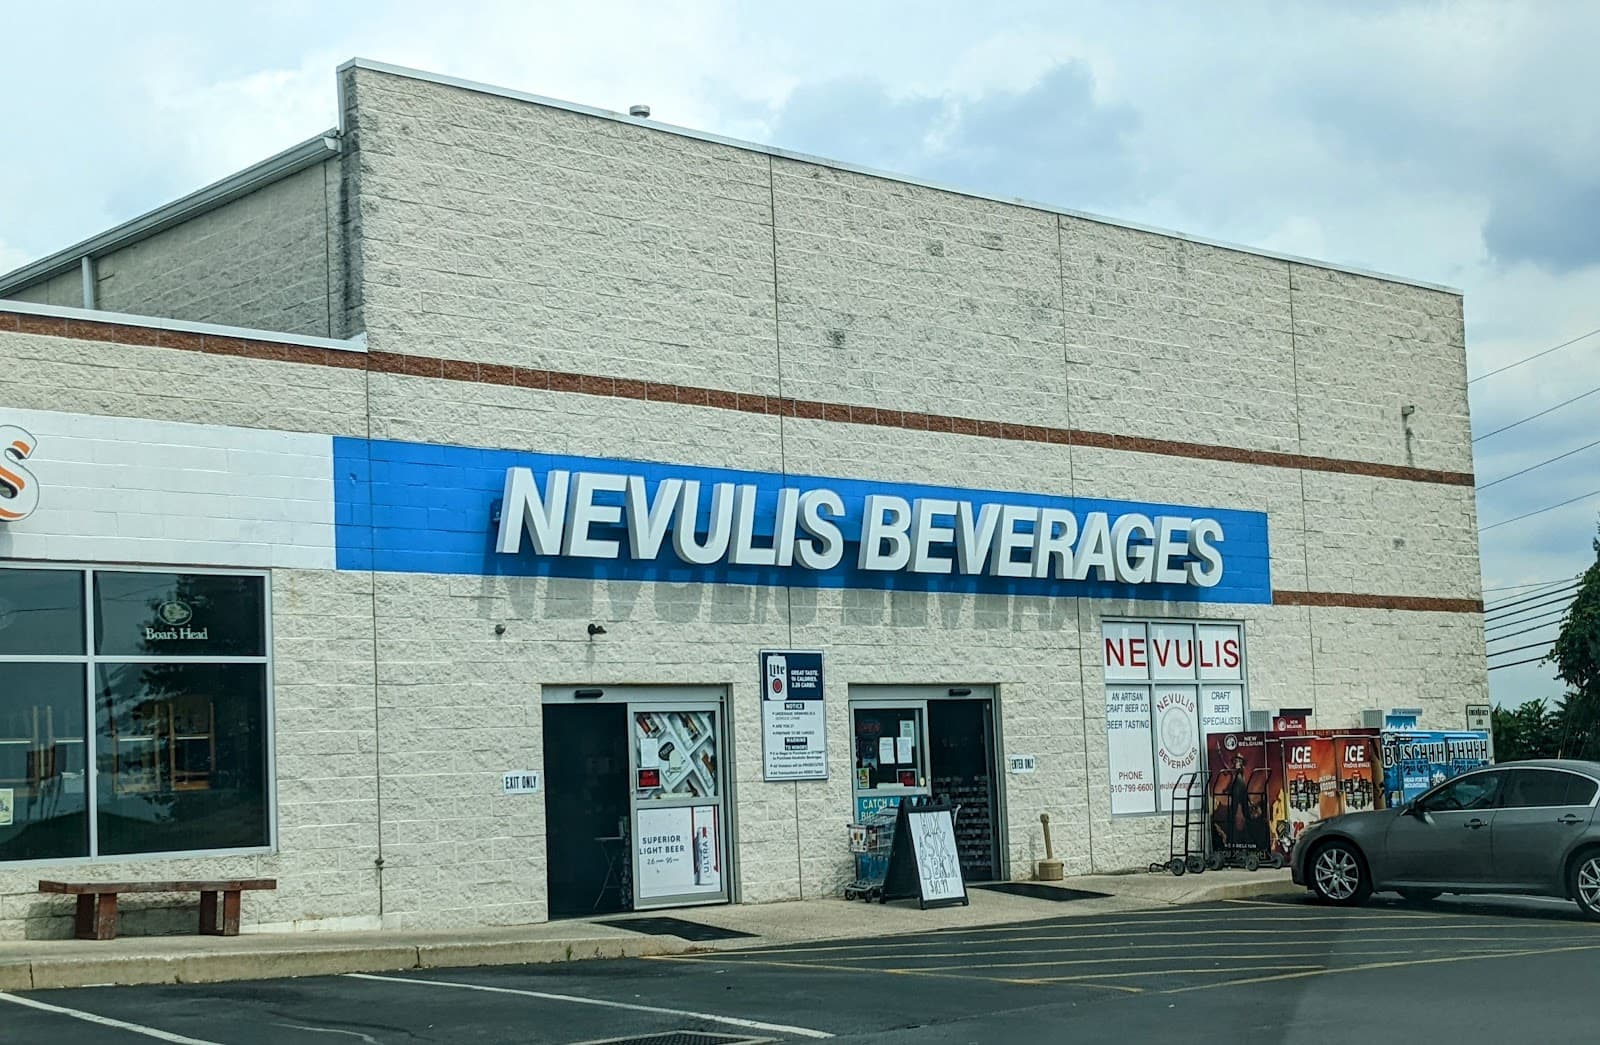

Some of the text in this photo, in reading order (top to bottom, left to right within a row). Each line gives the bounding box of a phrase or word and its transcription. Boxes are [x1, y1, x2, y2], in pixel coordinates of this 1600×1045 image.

[495, 467, 1224, 588] NEVULIS BEVERAGES
[145, 627, 208, 640] Boar's Head
[1105, 638, 1240, 668] NEVULIS
[769, 663, 785, 677] Lite
[1112, 692, 1144, 701] AN ARTISAN
[1211, 691, 1231, 700] CRAFT
[1106, 704, 1123, 713] CRAFT
[1125, 704, 1139, 713] BEER
[1157, 693, 1195, 713] NEVULIS
[1214, 704, 1230, 713] BEER
[1107, 720, 1149, 730] BEER TASTING
[1202, 716, 1242, 726] SPECIALISTS
[1158, 746, 1198, 769] BEVERAGES
[1291, 745, 1312, 763] ICE
[1344, 745, 1365, 762] ICE
[1011, 758, 1023, 769] ENTER
[1119, 771, 1143, 780] PHONE
[505, 776, 537, 789] EXIT ONLY
[863, 799, 887, 809] CATCH
[642, 834, 681, 845] SUPERIOR
[639, 845, 685, 855] LIGHT BEER
[702, 840, 710, 874] ULTRA
